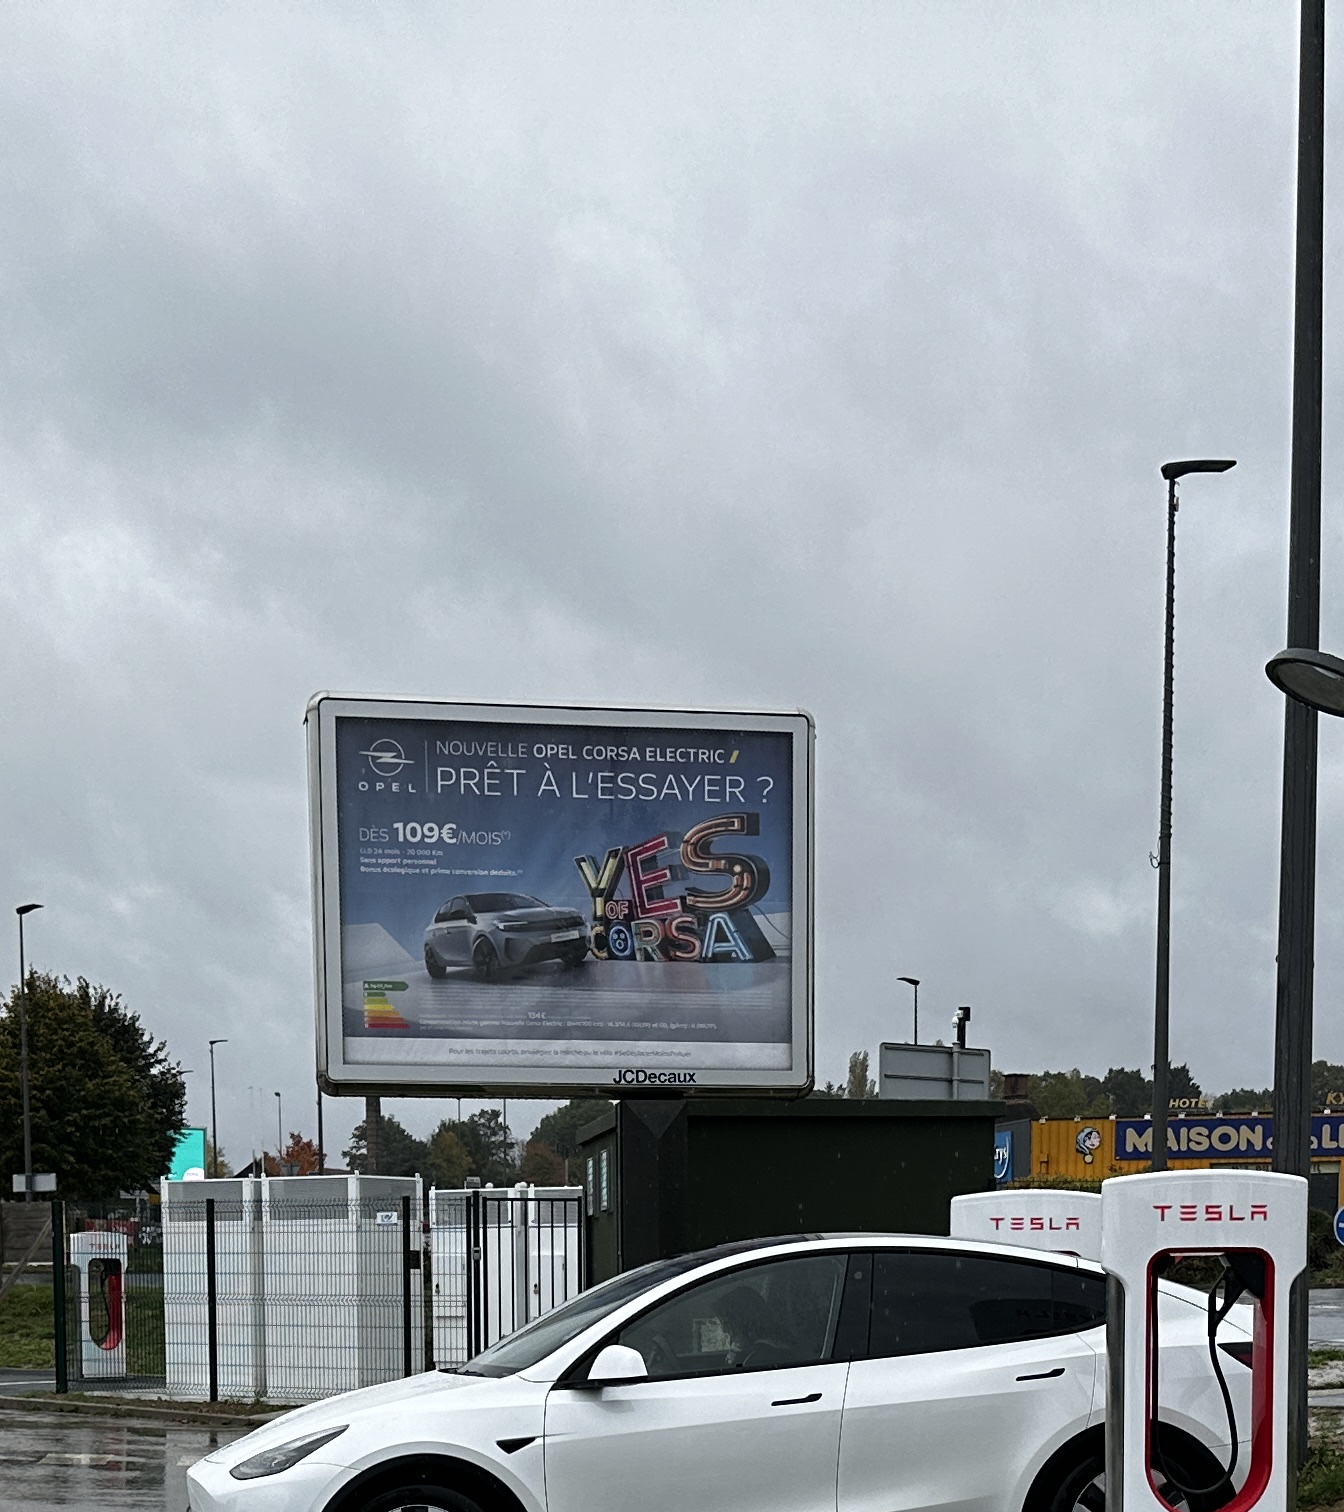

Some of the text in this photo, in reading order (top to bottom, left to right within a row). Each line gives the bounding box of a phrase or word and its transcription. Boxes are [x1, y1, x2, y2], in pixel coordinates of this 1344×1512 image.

[436, 740, 726, 764] NOUVELLE OPEL CORSA ELECTRIC
[358, 781, 416, 793] OPEL
[437, 761, 774, 804] PRÊT À L'ESSAYER ?
[359, 825, 390, 842] DÈS
[573, 813, 766, 921] YES
[606, 901, 629, 919] OF
[589, 911, 756, 961] CORSA
[612, 1069, 697, 1085] JCDecaux
[1153, 1203, 1269, 1223] TESLA
[990, 1216, 1081, 1232] TESLA
